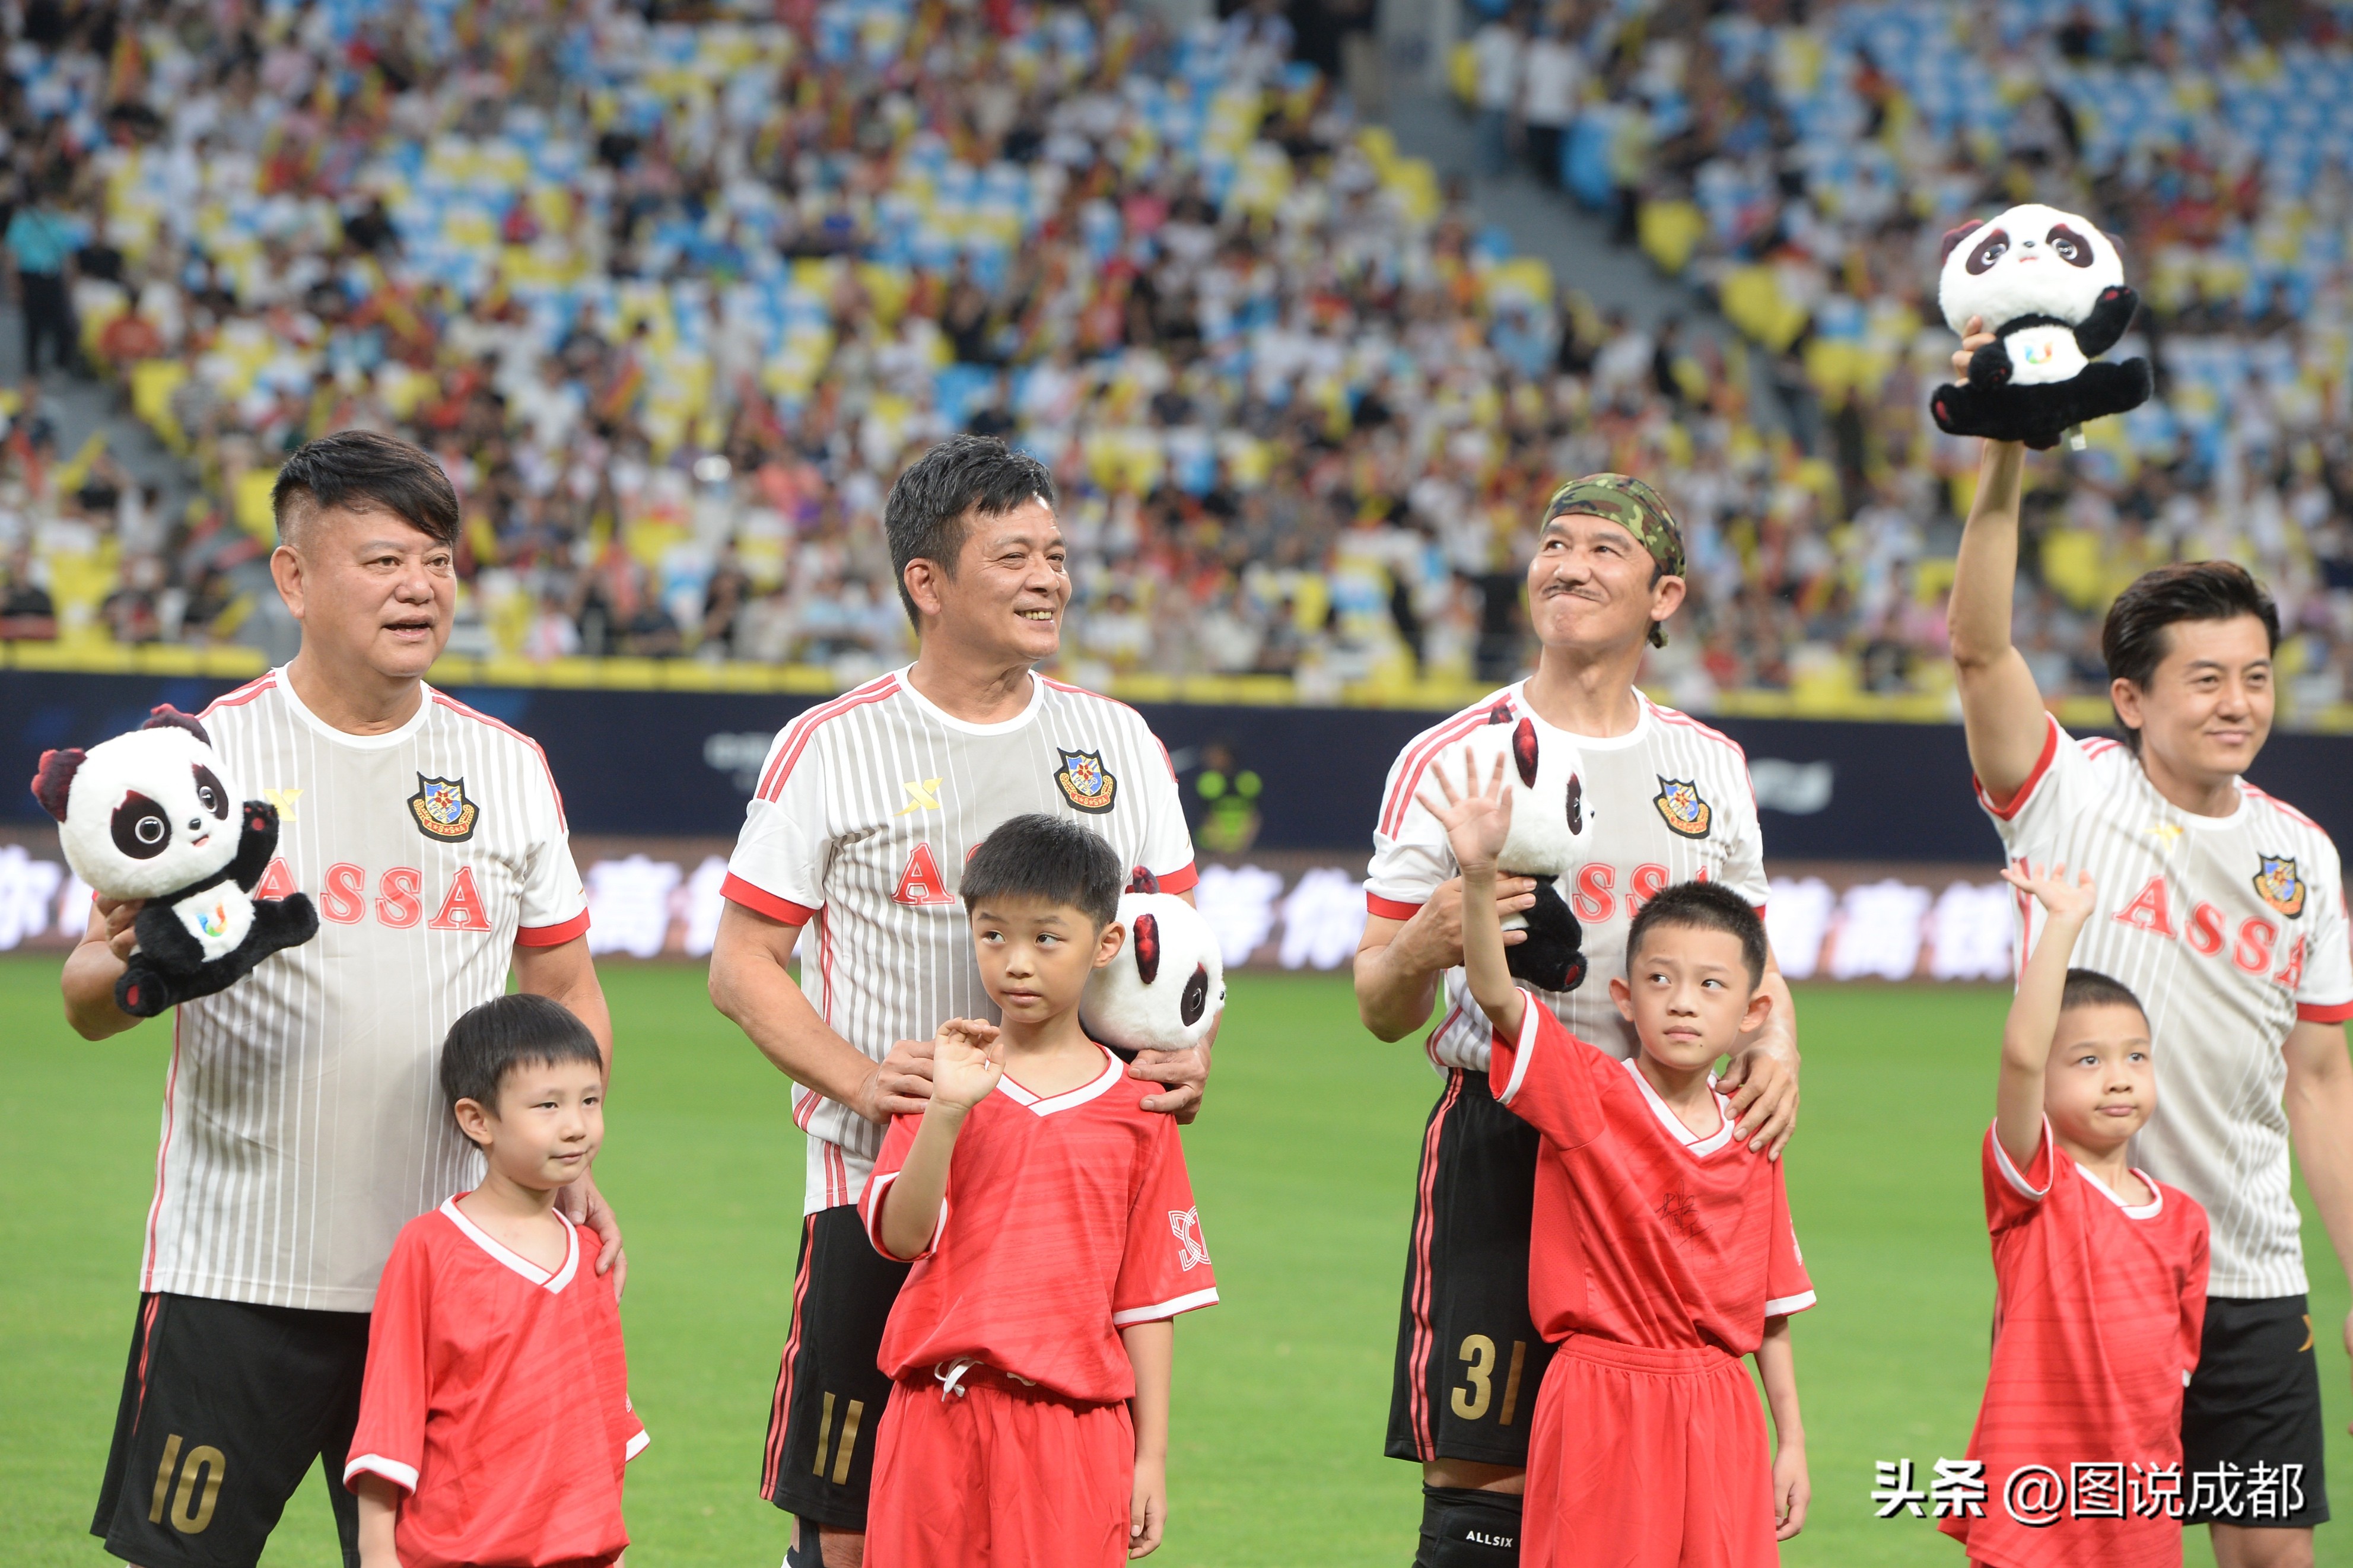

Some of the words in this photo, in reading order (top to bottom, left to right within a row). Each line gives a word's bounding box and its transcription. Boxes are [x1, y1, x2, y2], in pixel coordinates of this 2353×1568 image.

[254, 857, 492, 932] ASSA
[1451, 1334, 1527, 1426] 31
[148, 1433, 226, 1534] 10
[813, 1391, 864, 1485] 11
[1465, 1529, 1513, 1548] ALLSIX
